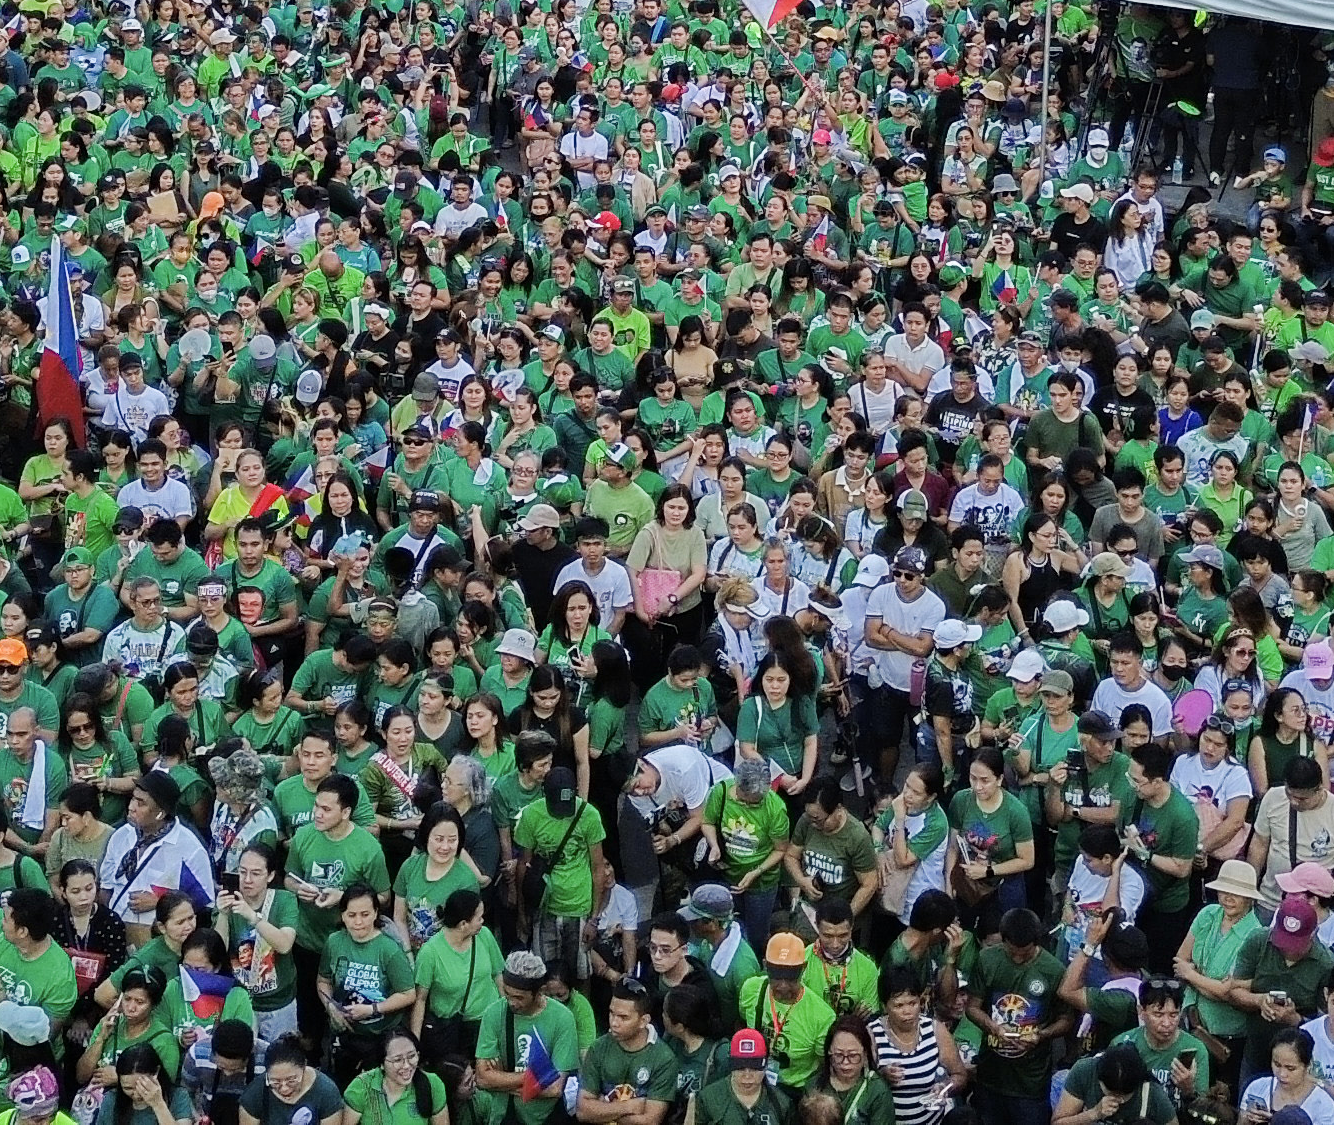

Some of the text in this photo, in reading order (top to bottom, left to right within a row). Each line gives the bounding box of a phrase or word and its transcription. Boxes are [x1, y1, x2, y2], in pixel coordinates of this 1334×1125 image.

[347, 969, 379, 980] GLOBAL
[344, 977, 380, 989] FILIPINO
[1151, 1068, 1169, 1083] NOT
